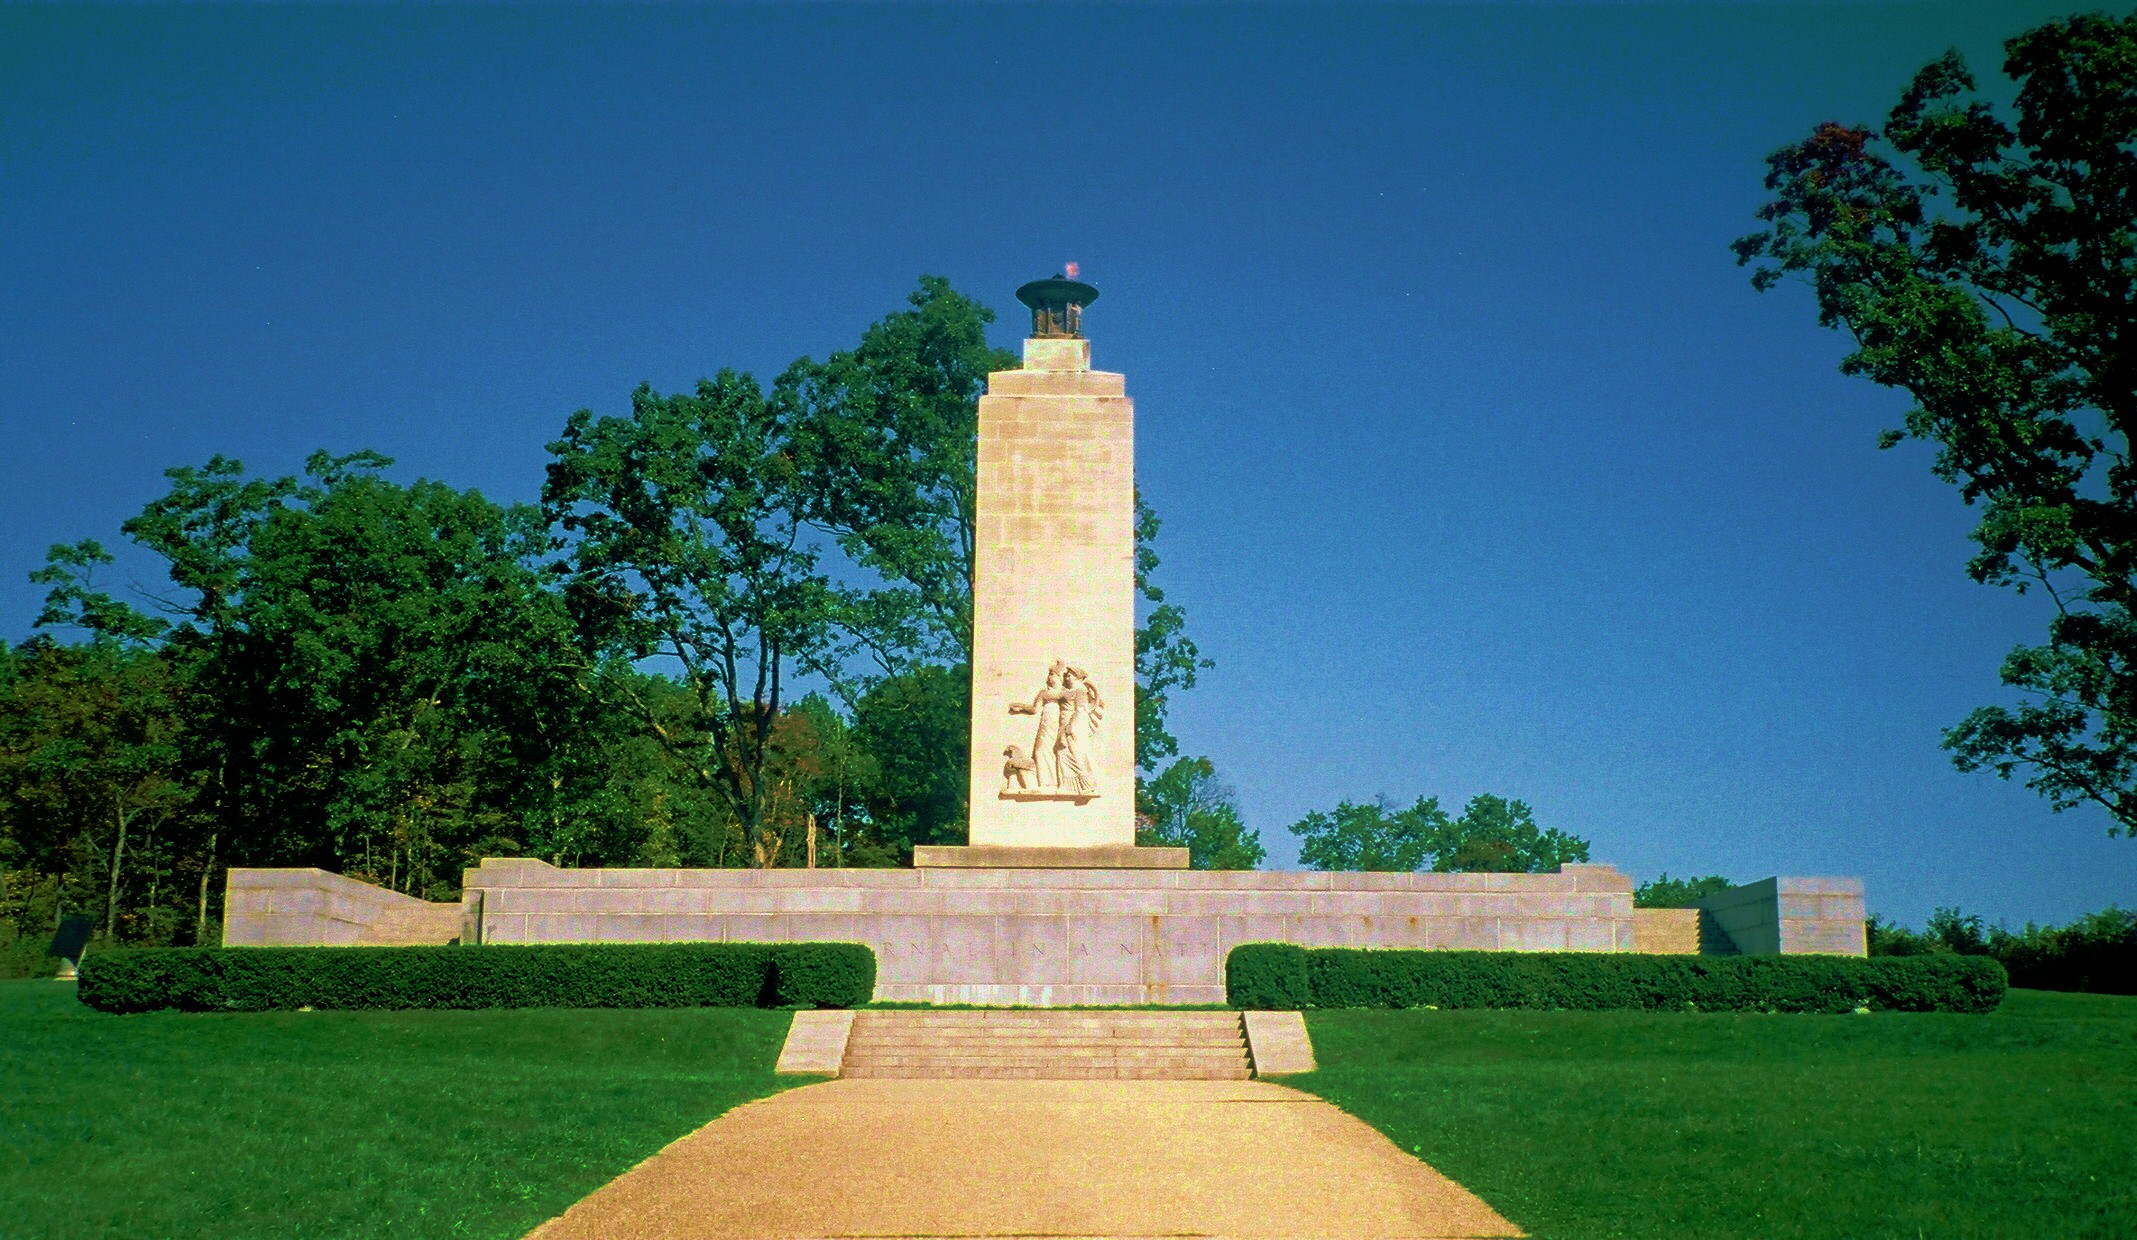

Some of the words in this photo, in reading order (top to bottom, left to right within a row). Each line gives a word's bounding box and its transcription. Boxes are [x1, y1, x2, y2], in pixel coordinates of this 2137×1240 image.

[881, 941, 978, 958] RNAL
[1009, 941, 1046, 957] IN
[1077, 942, 1090, 957] A
[1118, 942, 1229, 957] NATI
